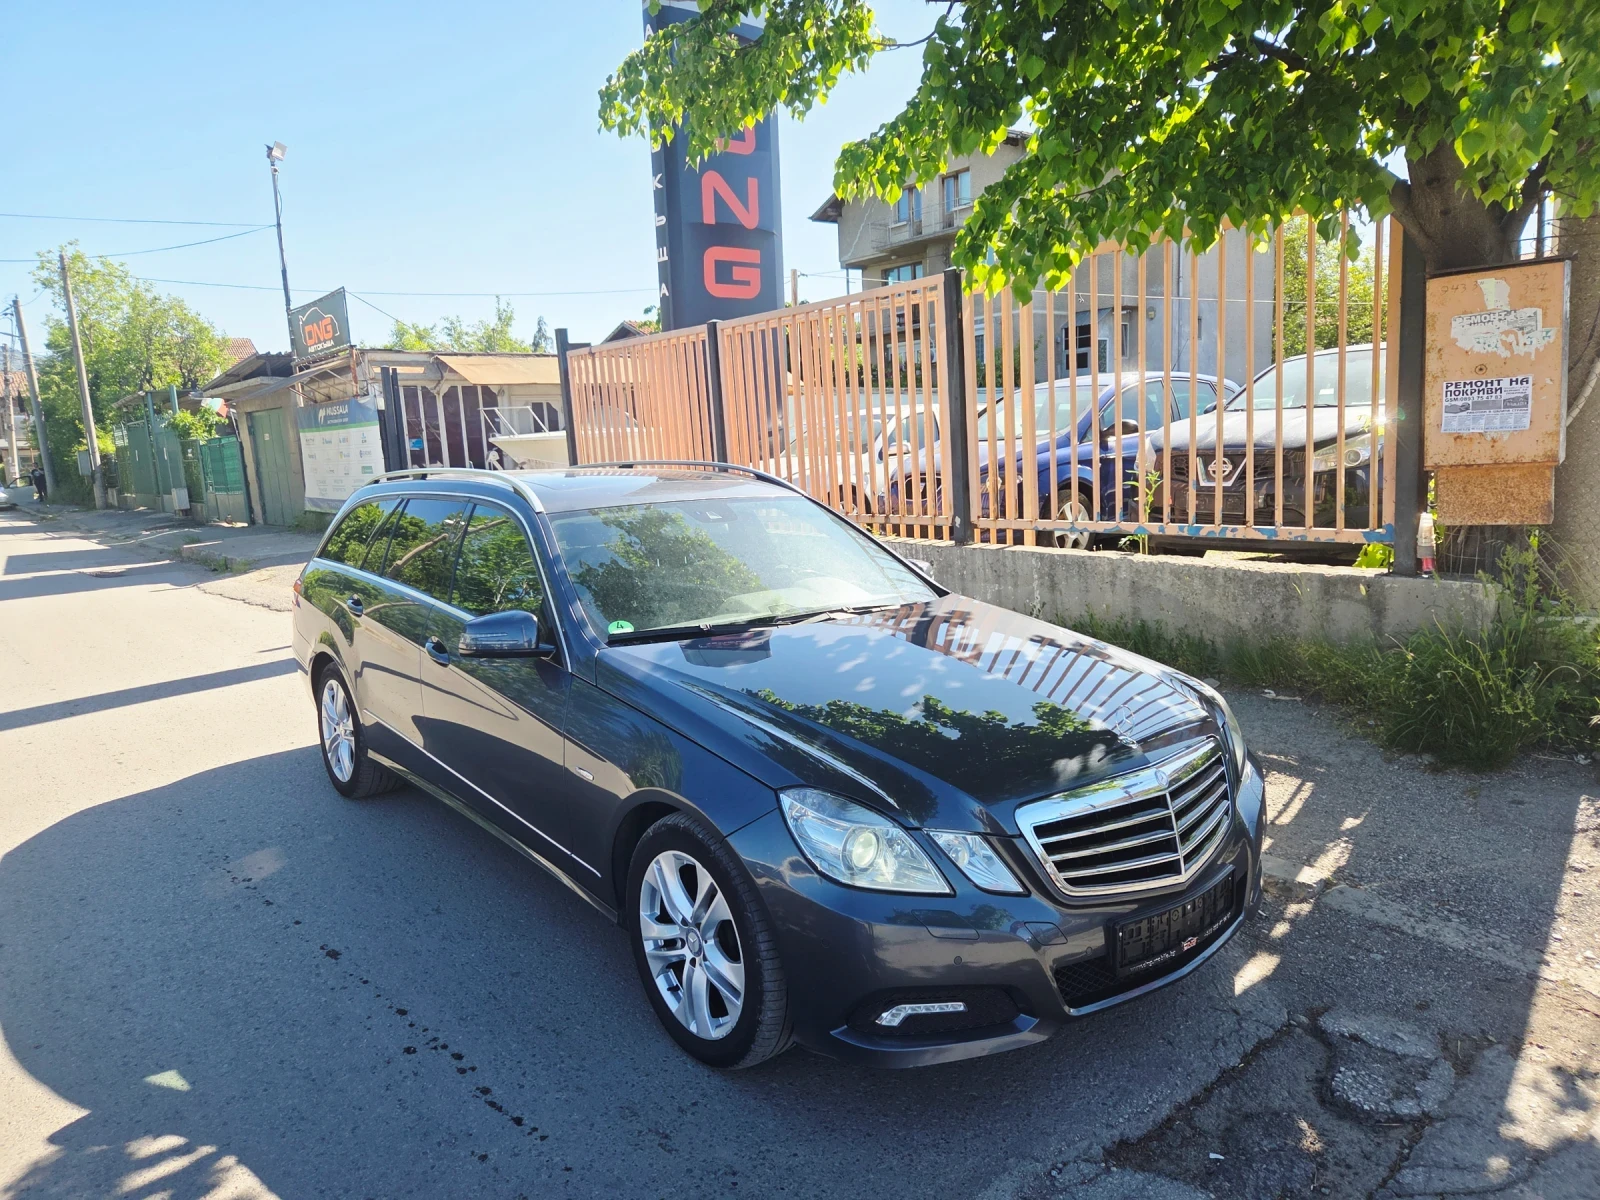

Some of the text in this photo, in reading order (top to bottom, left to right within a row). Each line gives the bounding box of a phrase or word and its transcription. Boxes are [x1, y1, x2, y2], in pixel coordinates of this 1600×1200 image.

[304, 317, 333, 346] DNG
[1445, 377, 1529, 389] РЕМОНТ НА
[1445, 387, 1503, 398] ПОКРИВИ
